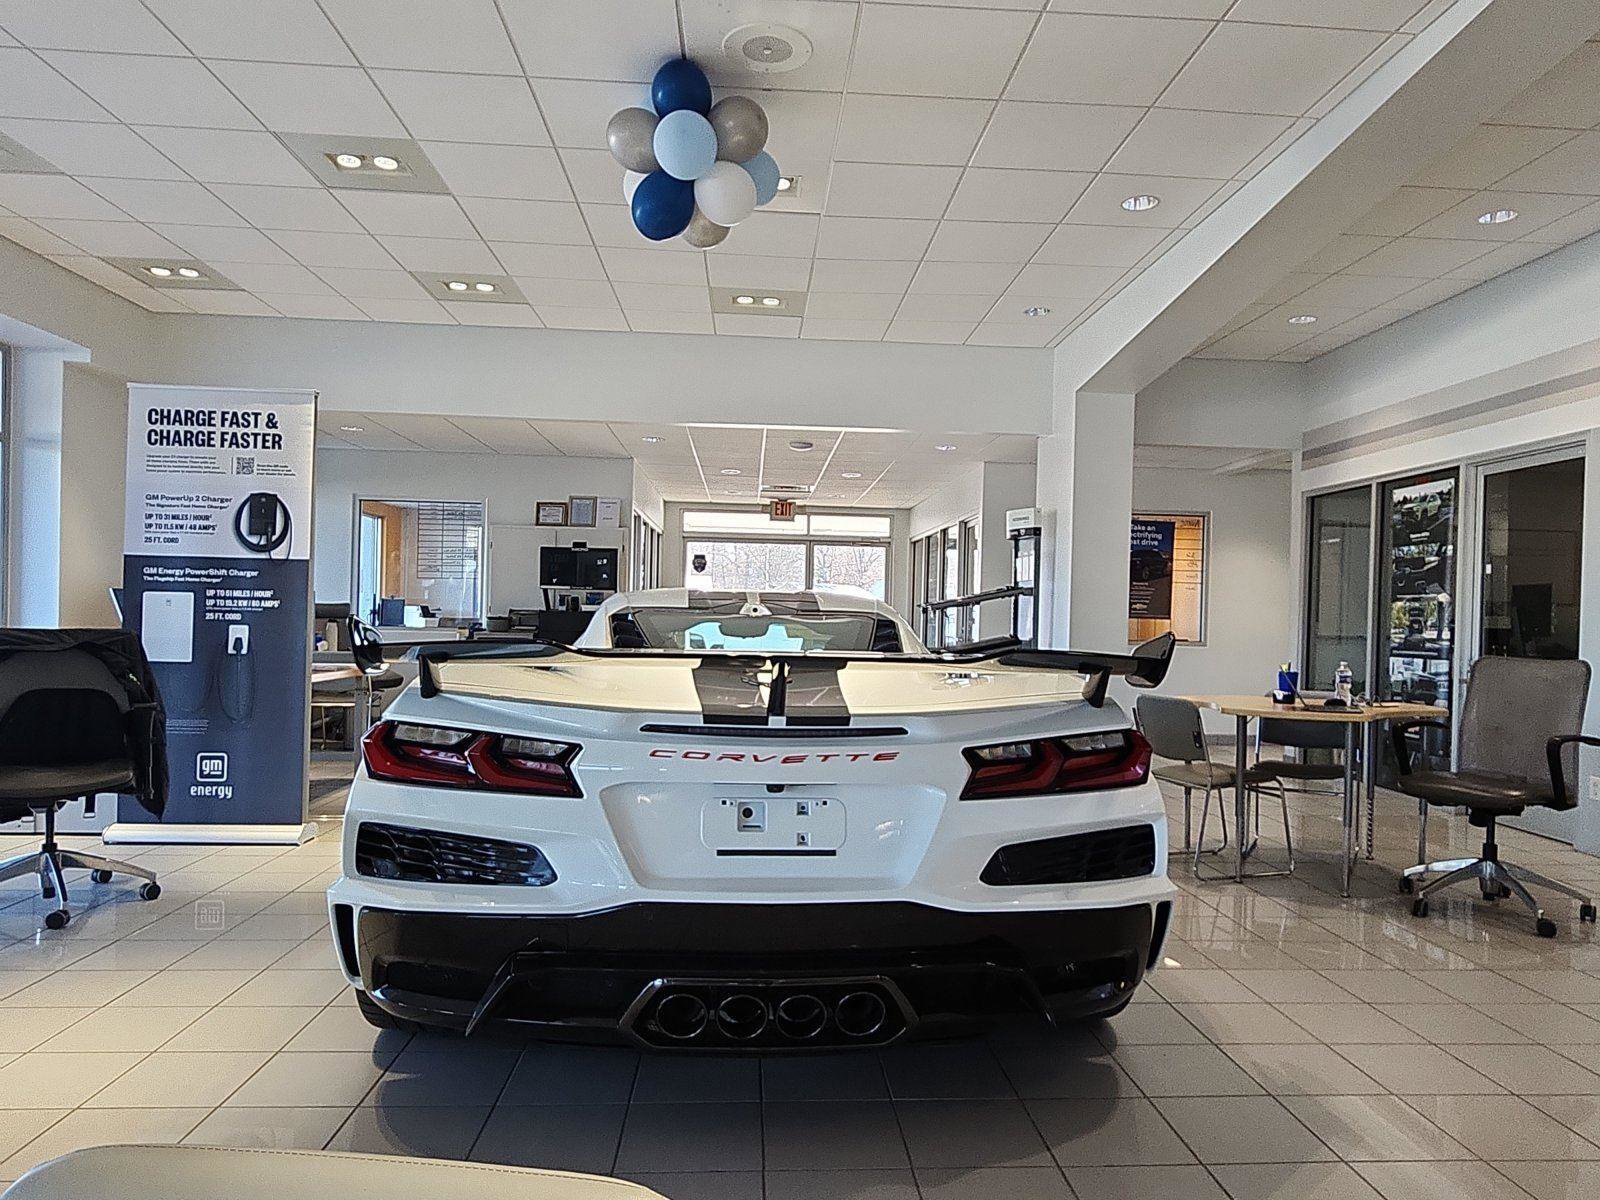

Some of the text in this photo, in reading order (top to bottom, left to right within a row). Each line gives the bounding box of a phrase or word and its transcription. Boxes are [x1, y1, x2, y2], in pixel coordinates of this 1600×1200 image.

[147, 408, 279, 430] CHARGE FAST &
[147, 428, 283, 450] CHARGE FASTER
[145, 493, 159, 501] GM
[160, 494, 194, 503] PowerUp
[201, 495, 233, 504] Charger
[774, 502, 793, 517] EXIT
[144, 512, 154, 520] UP
[155, 513, 163, 521] TO
[144, 522, 154, 530] UP
[155, 522, 163, 530] TO
[144, 536, 153, 544] 25
[1130, 532, 1163, 540] ctrifying
[143, 566, 260, 578] GM Energy PowerShift Charger
[206, 589, 216, 597] UP
[216, 590, 225, 598] TO
[206, 599, 216, 607] UP
[216, 600, 225, 608] TO
[205, 612, 215, 621] 25
[224, 613, 242, 621] CORD
[649, 749, 900, 765] CORVETTE
[202, 759, 222, 775] gm
[190, 785, 233, 799] energy
